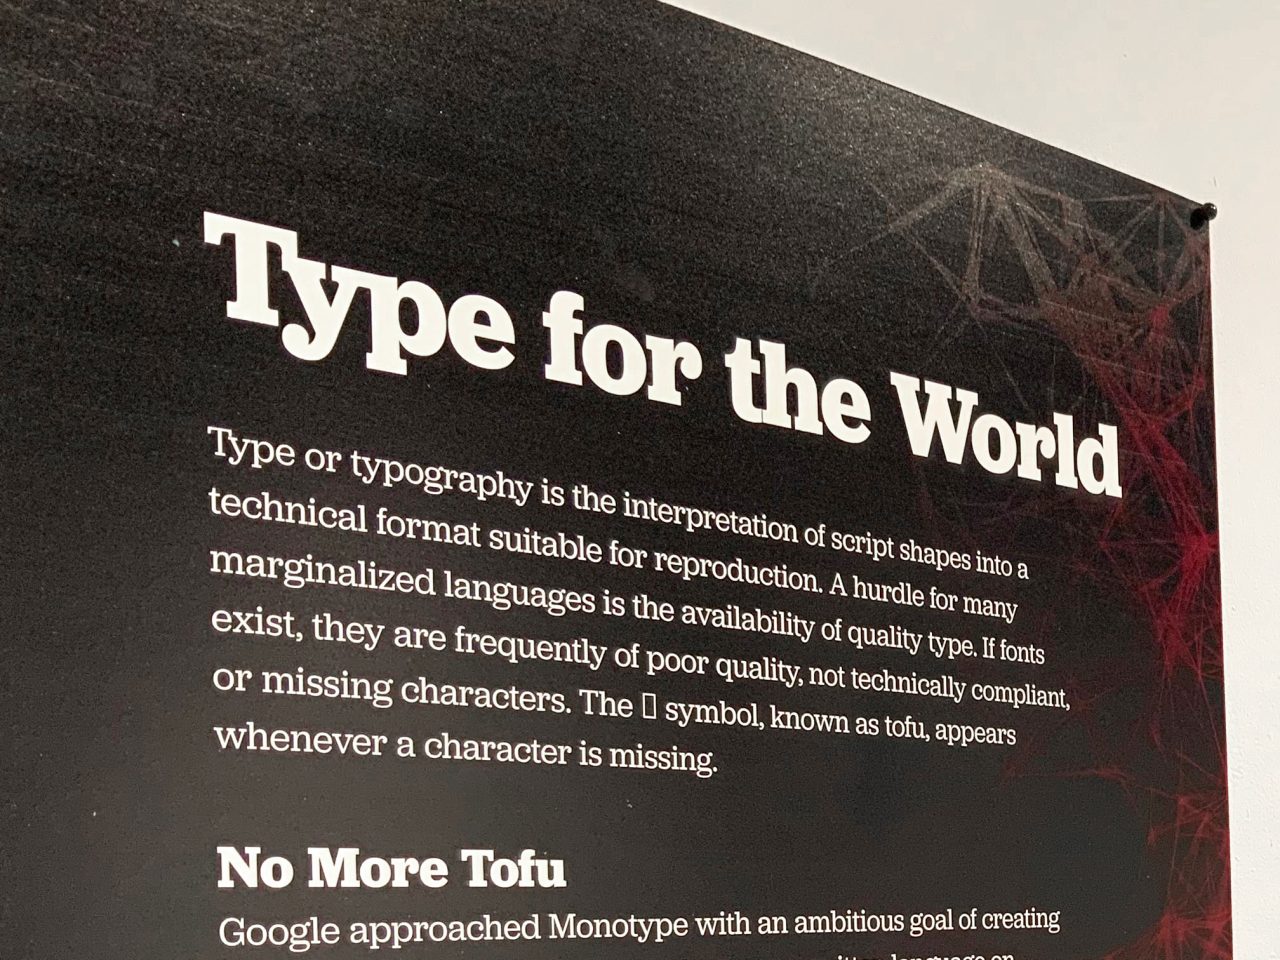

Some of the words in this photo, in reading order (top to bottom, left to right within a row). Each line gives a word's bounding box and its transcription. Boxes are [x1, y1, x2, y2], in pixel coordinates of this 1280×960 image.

[203, 210, 516, 376] Type
[541, 290, 703, 407] for
[724, 336, 872, 444] the
[889, 371, 1123, 499] World
[206, 425, 296, 469] Type
[304, 448, 343, 473] or
[349, 450, 535, 507] typography
[540, 477, 565, 507] is
[571, 484, 617, 515] the
[622, 491, 799, 544] interpretation
[803, 523, 827, 548] of
[831, 531, 895, 562] script
[899, 538, 972, 572] shapes
[975, 549, 1013, 577] into
[1017, 562, 1030, 580] a
[207, 486, 369, 533] technical
[375, 506, 482, 548] format
[488, 526, 603, 563] suitable
[608, 539, 648, 569] for
[653, 551, 824, 594] reproduction.
[828, 572, 848, 597] A
[852, 574, 925, 608] hurdle
[929, 586, 959, 612] for
[962, 596, 1019, 625] many
[209, 550, 437, 596] marginalized
[443, 569, 596, 617] languages
[602, 588, 626, 617] is
[631, 593, 675, 622] the
[681, 604, 816, 643] availability
[820, 617, 843, 642] of
[847, 624, 924, 656] quality
[927, 631, 978, 660] type.
[981, 636, 996, 659] If
[999, 638, 1046, 665] fonts
[211, 605, 304, 643] exist,
[311, 612, 386, 652] they
[393, 626, 447, 651] are
[454, 625, 608, 671] frequently
[614, 642, 641, 669] of
[645, 650, 710, 676] poor
[715, 656, 804, 689] quality,
[808, 666, 846, 688] not
[850, 667, 967, 704] technically
[971, 683, 1071, 712] compliant,
[216, 845, 295, 889] No
[306, 846, 449, 889] More
[460, 848, 568, 889] Tofu
[218, 916, 341, 953] Google
[349, 913, 542, 950] approached
[547, 912, 689, 943] Monotype
[694, 910, 752, 936] with
[757, 915, 789, 935] an
[794, 909, 905, 934] ambitious
[909, 908, 955, 938] goal
[958, 907, 978, 931] of
[981, 906, 1061, 934] creating
